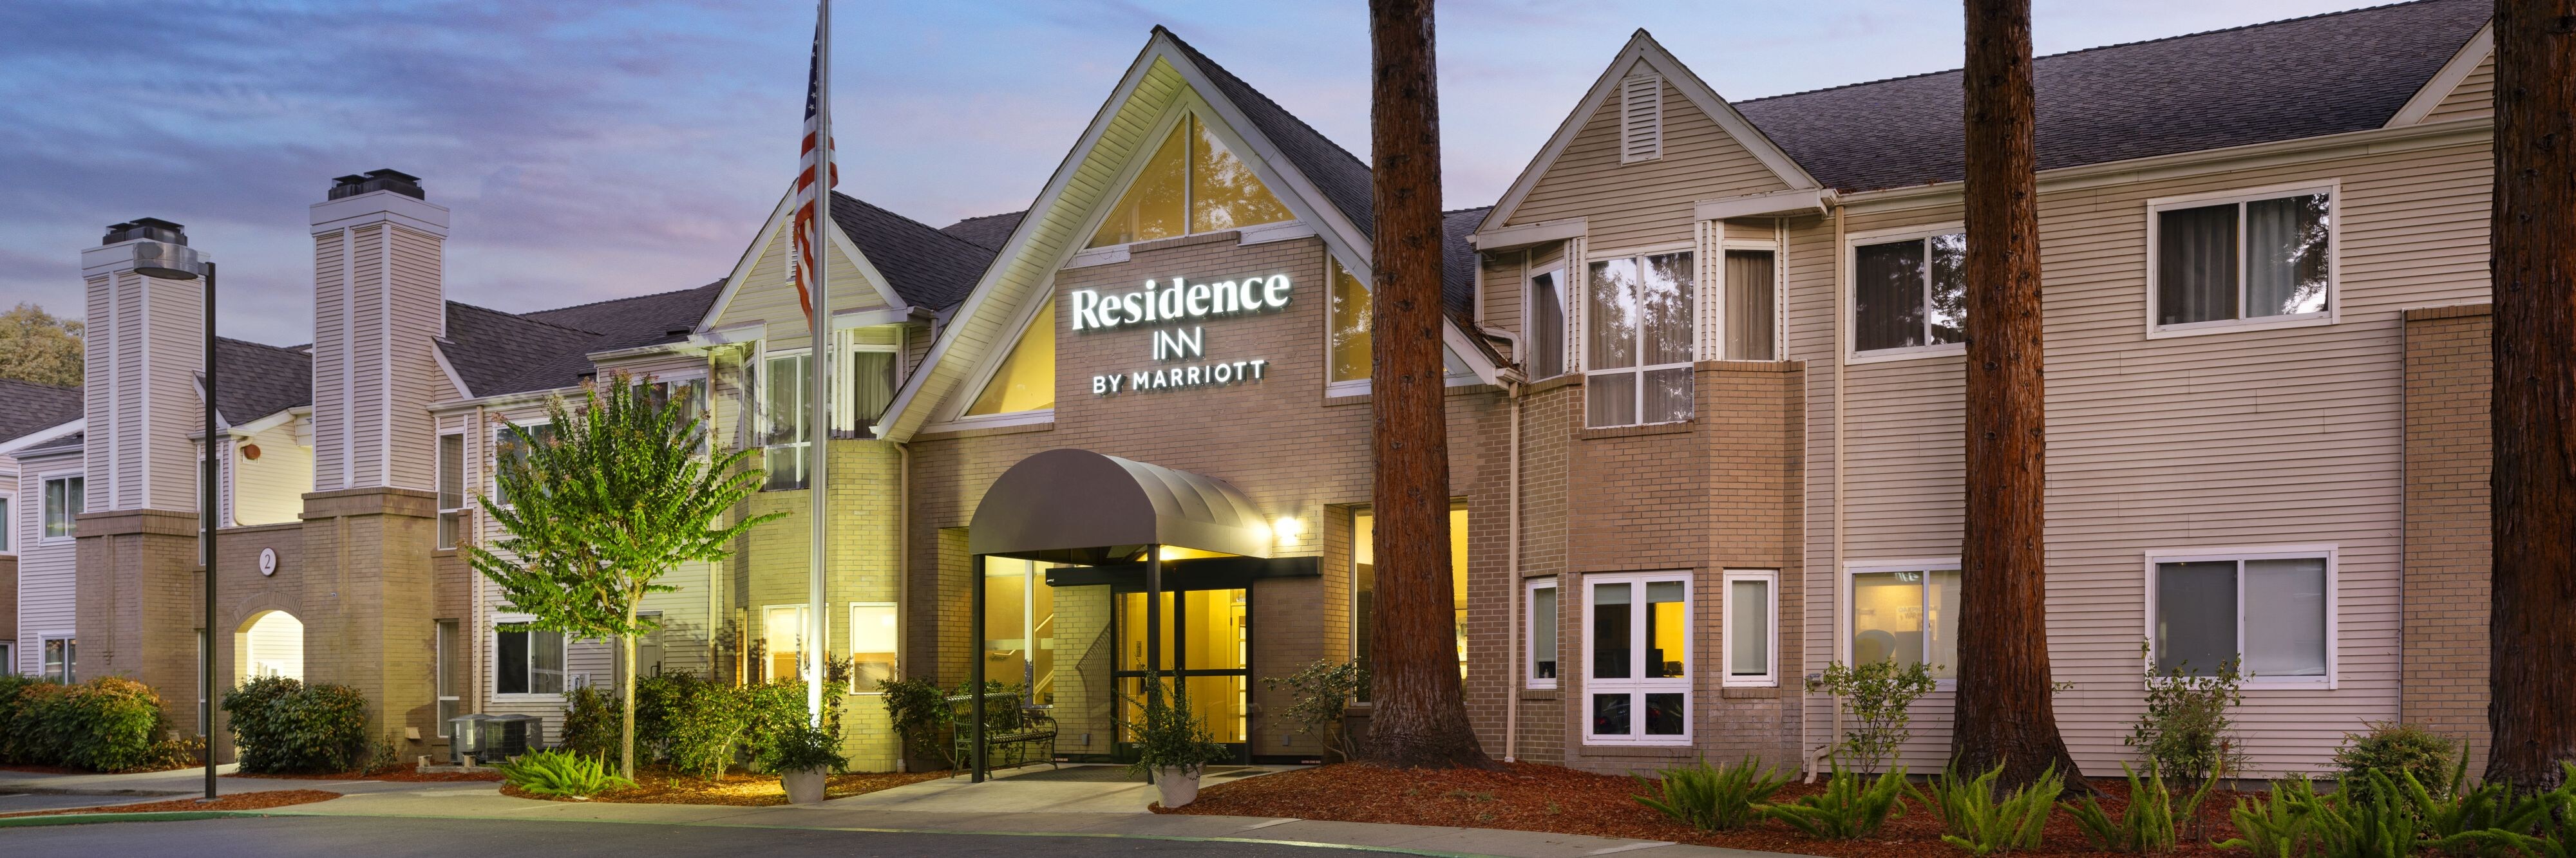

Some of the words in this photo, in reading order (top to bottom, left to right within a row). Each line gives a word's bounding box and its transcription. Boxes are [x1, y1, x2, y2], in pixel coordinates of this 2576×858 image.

[1072, 274, 1290, 330] Residence
[1153, 326, 1201, 360] INN
[1093, 374, 1122, 394] BY
[1133, 359, 1265, 390] MARRIOTT
[265, 554, 270, 569] 2
